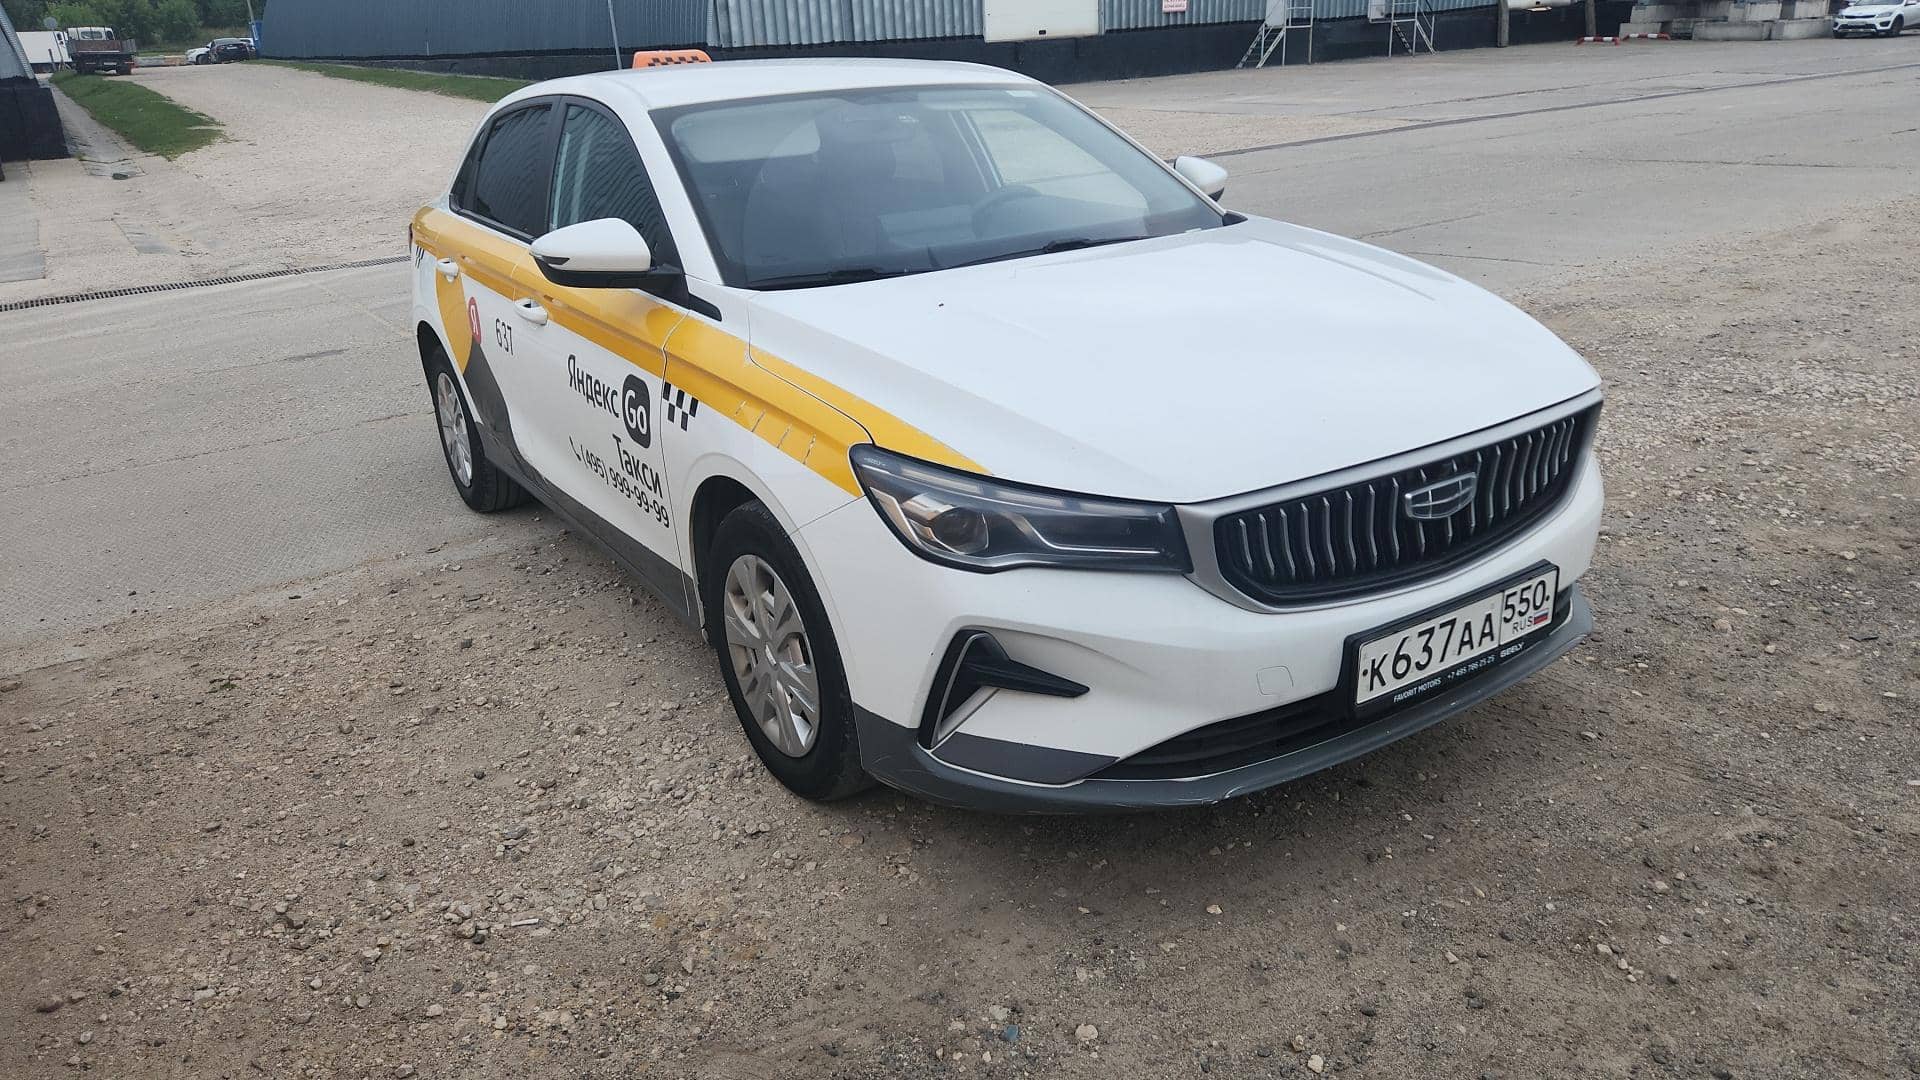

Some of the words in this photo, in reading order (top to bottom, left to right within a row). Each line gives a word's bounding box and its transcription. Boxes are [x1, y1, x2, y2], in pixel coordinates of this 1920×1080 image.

[470, 304, 479, 337] Я
[495, 318, 513, 356] 637
[567, 354, 619, 418] Яндекс
[624, 389, 649, 435] Go
[580, 444, 609, 485] (495)
[609, 467, 670, 528] 999-99-99
[612, 433, 663, 499] Такси
[1369, 612, 1495, 692] К637АА
[1503, 580, 1546, 623] 550
[1512, 616, 1533, 634] RUS
[1393, 688, 1417, 703] FAVORIT
[1418, 677, 1442, 692] MOTORS
